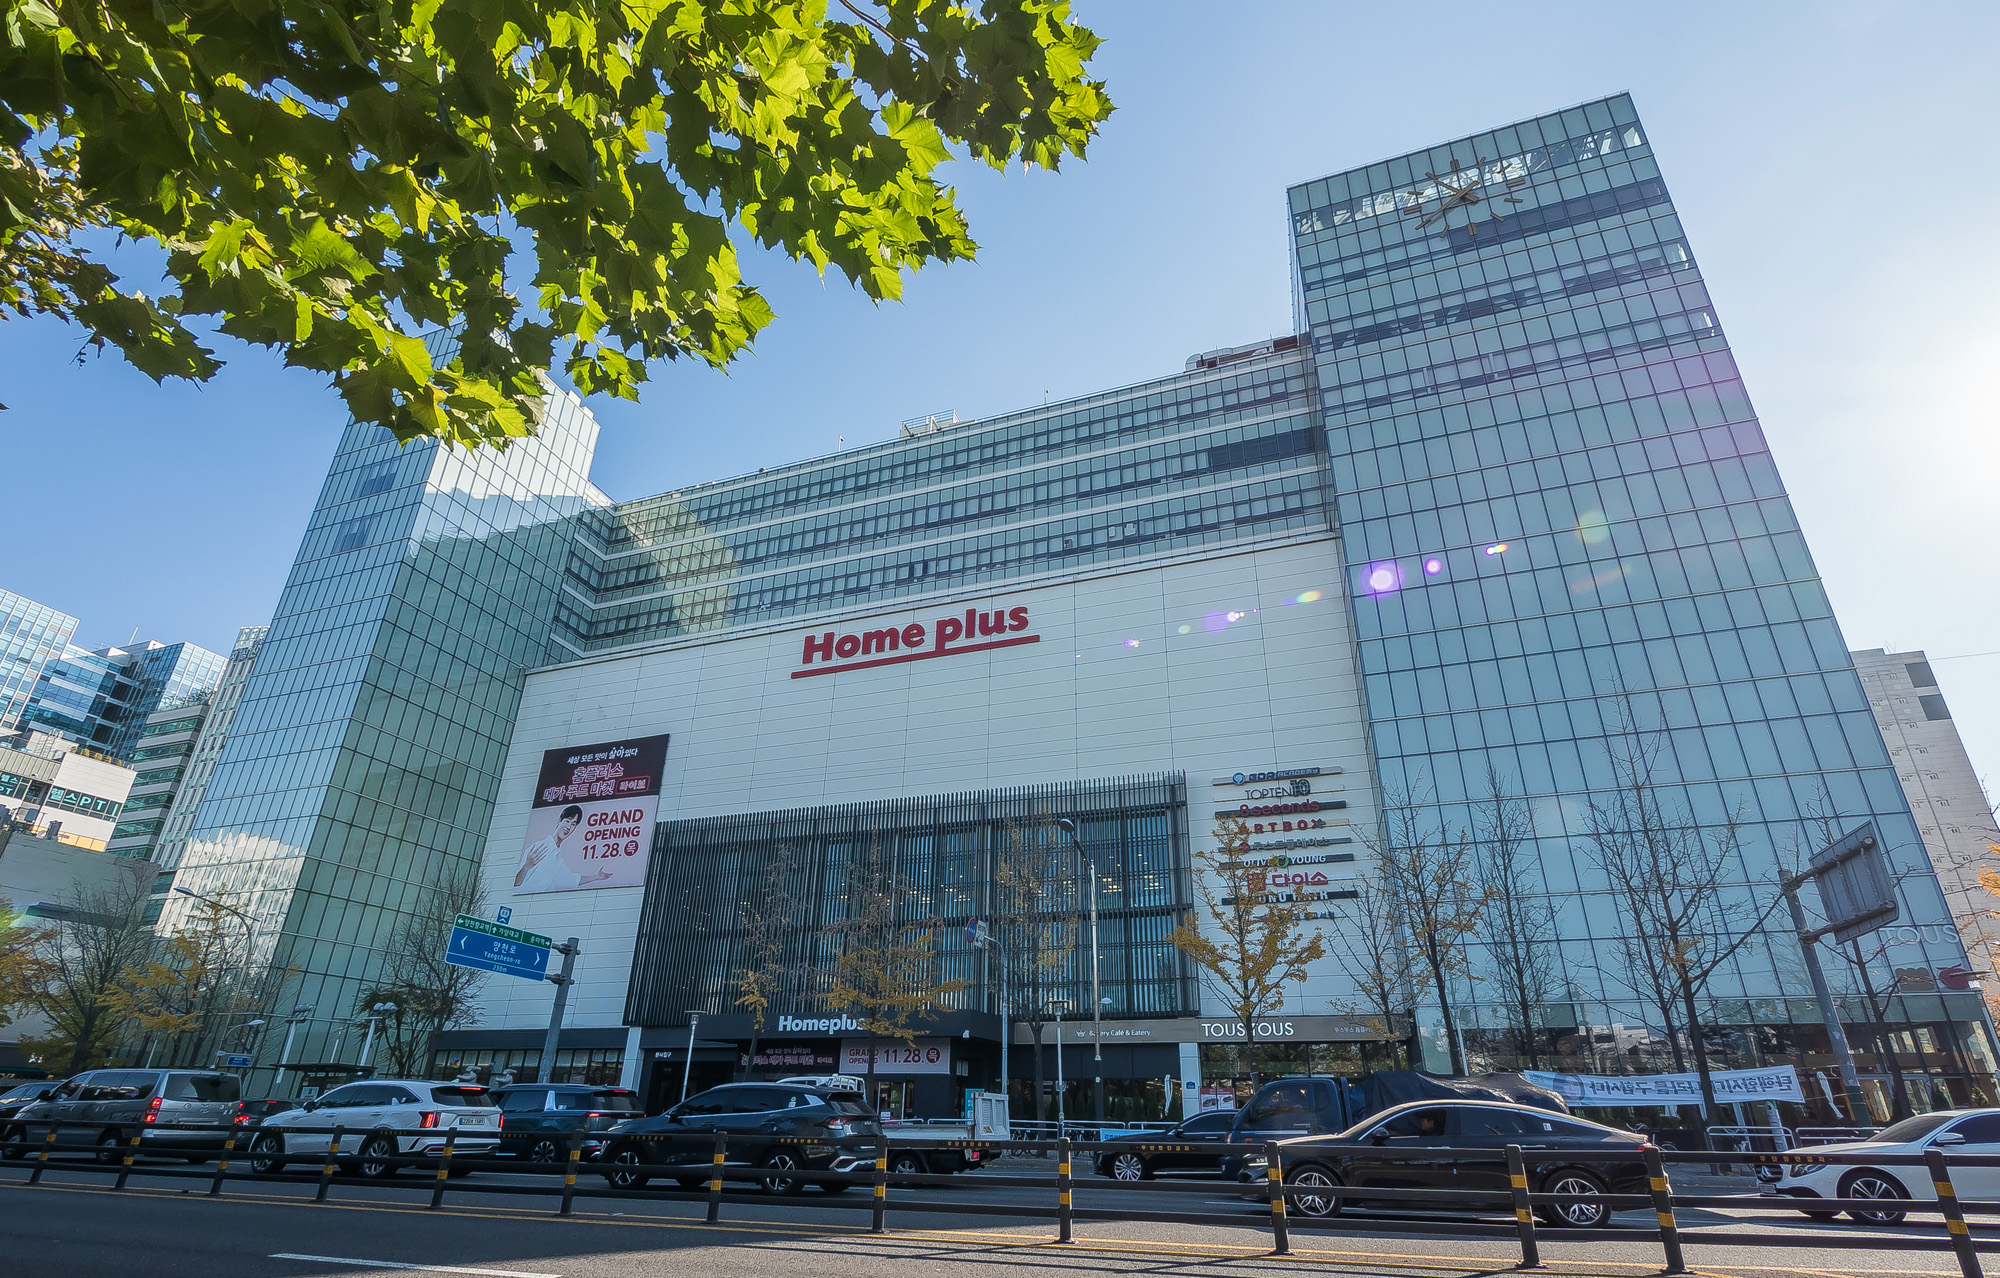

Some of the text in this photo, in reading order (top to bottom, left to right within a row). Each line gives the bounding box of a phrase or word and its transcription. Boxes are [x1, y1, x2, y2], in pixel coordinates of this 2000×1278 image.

[802, 607, 1029, 664] Home plus
[572, 763, 624, 784] 홈플러스
[1277, 768, 1318, 777] ACADEMY
[543, 786, 566, 802] 메가
[566, 784, 589, 800] 푸드
[590, 779, 616, 796] 마켓
[1240, 798, 1321, 817] 8 seconds
[588, 809, 644, 826] GRAND
[584, 826, 641, 841] OPENING
[1291, 855, 1326, 864] YOUNG
[1272, 871, 1328, 887] 다이소
[493, 941, 517, 954] 양천로
[778, 1013, 866, 1035] Homeplus
[1110, 1029, 1124, 1037] Café
